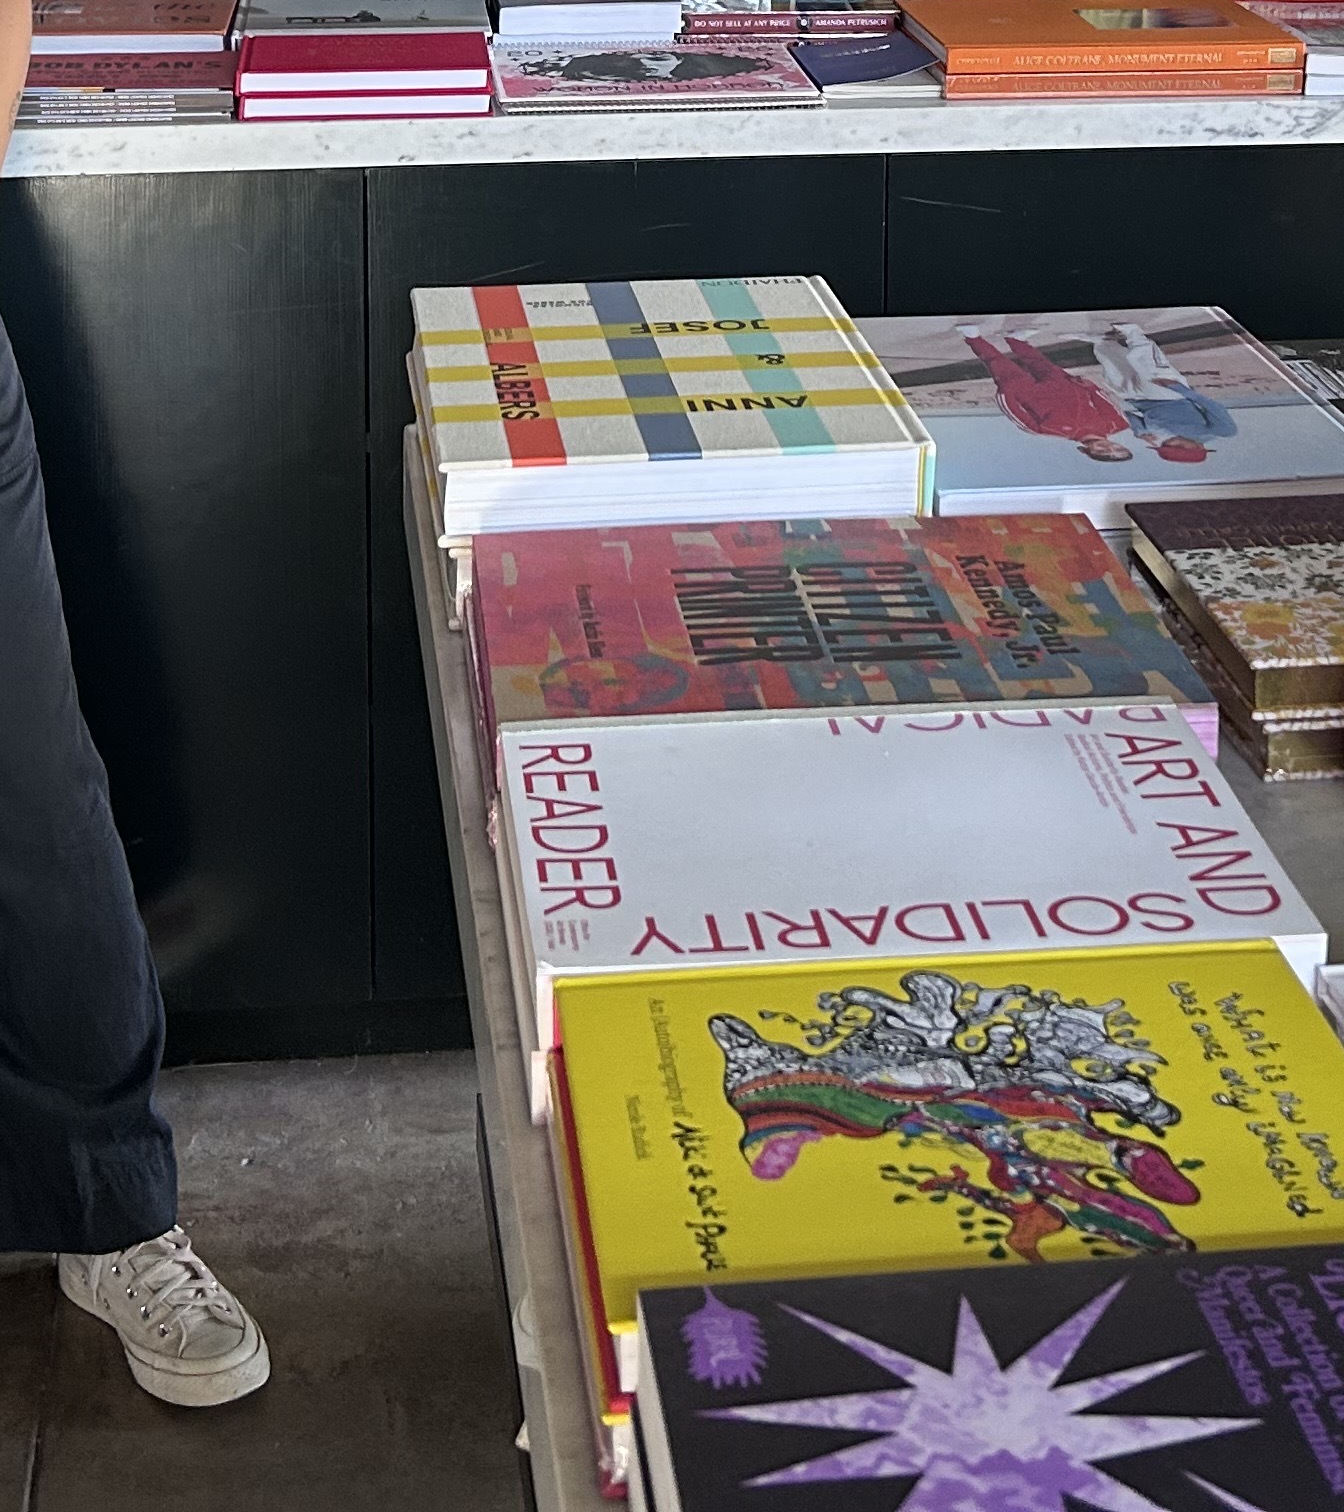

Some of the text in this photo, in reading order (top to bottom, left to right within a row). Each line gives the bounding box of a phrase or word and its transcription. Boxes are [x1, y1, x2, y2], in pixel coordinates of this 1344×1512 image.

[628, 318, 770, 334] JOSEF
[757, 353, 786, 366] &
[490, 362, 539, 421] ALBERS
[686, 395, 808, 412] ANNI
[518, 742, 623, 916] READER
[1101, 731, 1283, 918] ART AND
[628, 891, 1196, 958] SOLIDARITY
